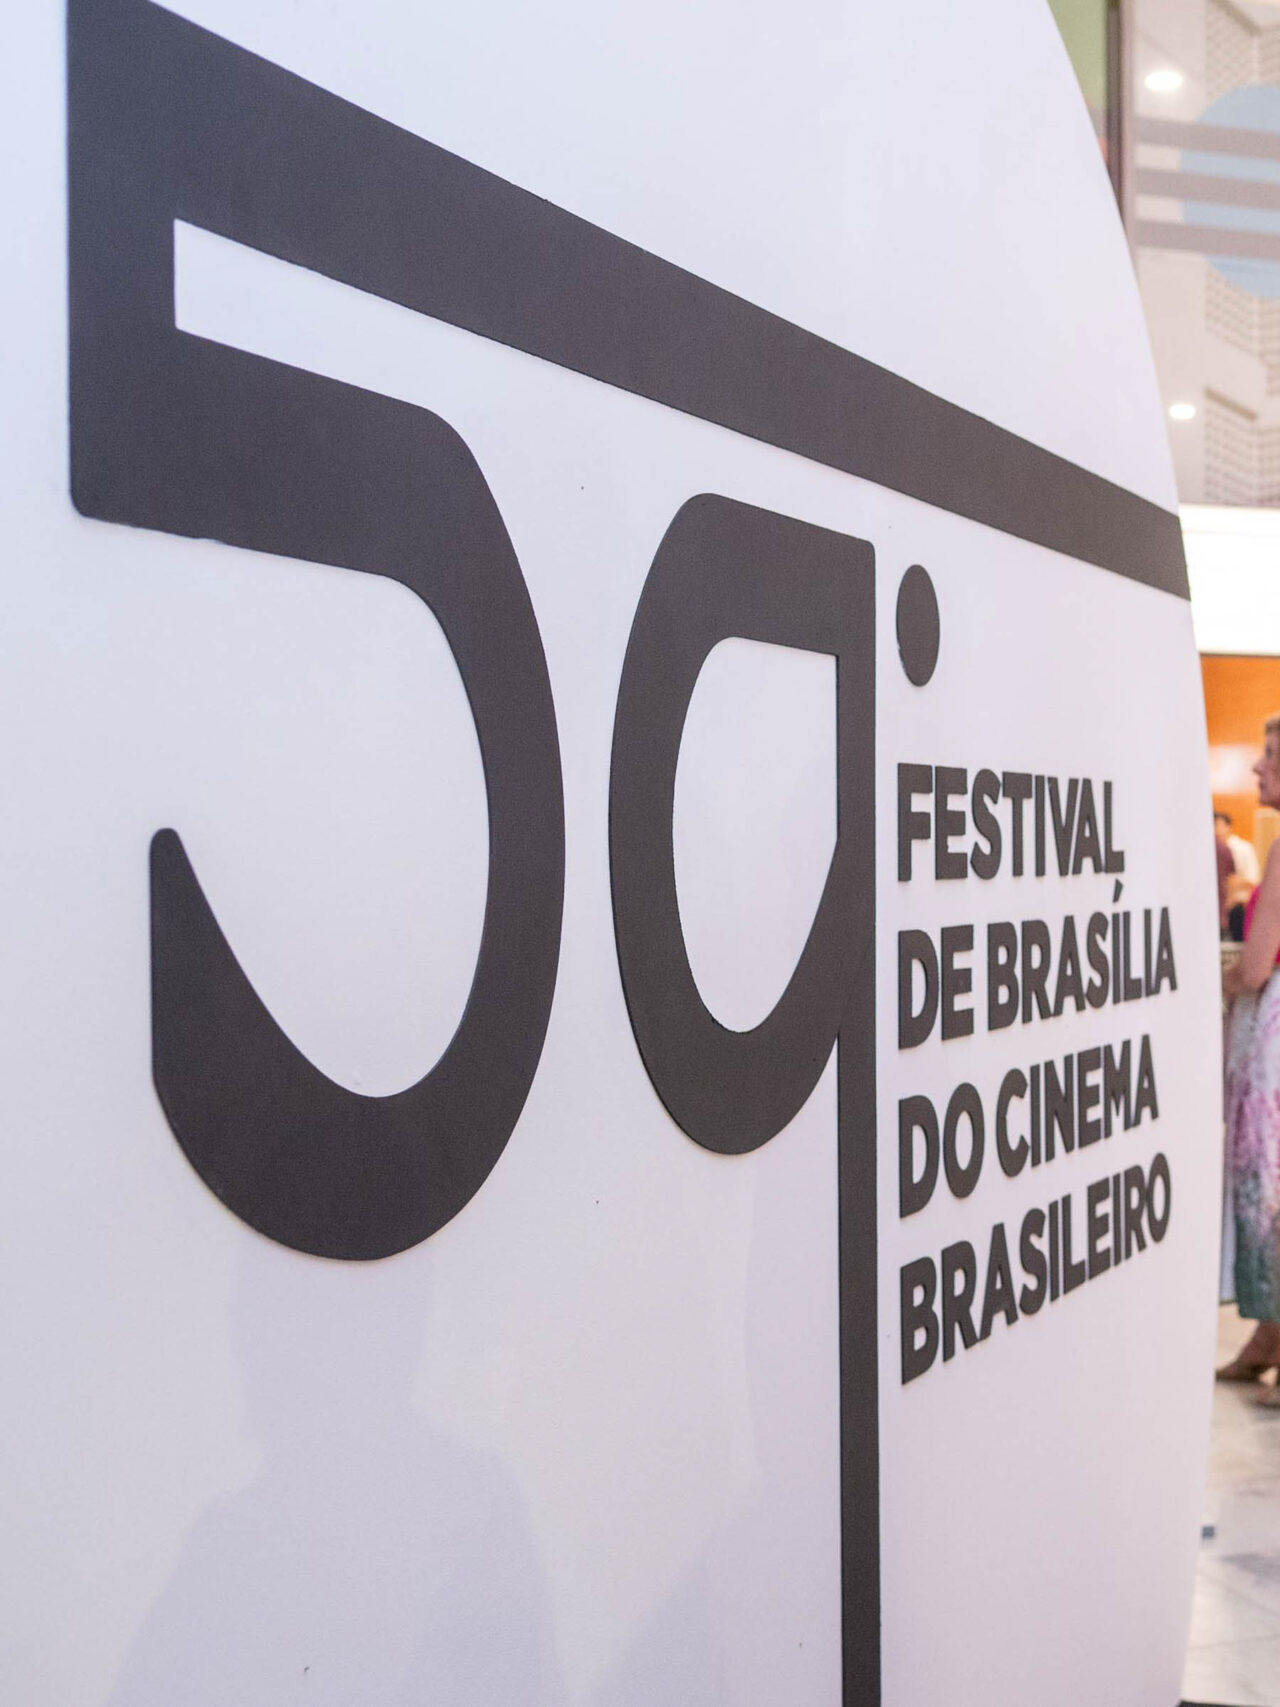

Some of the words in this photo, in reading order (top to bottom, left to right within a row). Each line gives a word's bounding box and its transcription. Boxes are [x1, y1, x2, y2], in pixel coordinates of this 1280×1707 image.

[897, 763, 1124, 882] FESTIVAL
[898, 924, 975, 1050] DE
[988, 878, 1177, 1031] BRASÍLIA
[899, 1082, 985, 1219] DO
[995, 1034, 1159, 1178] CINEMA
[901, 1153, 1171, 1385] BRASILEIRO
